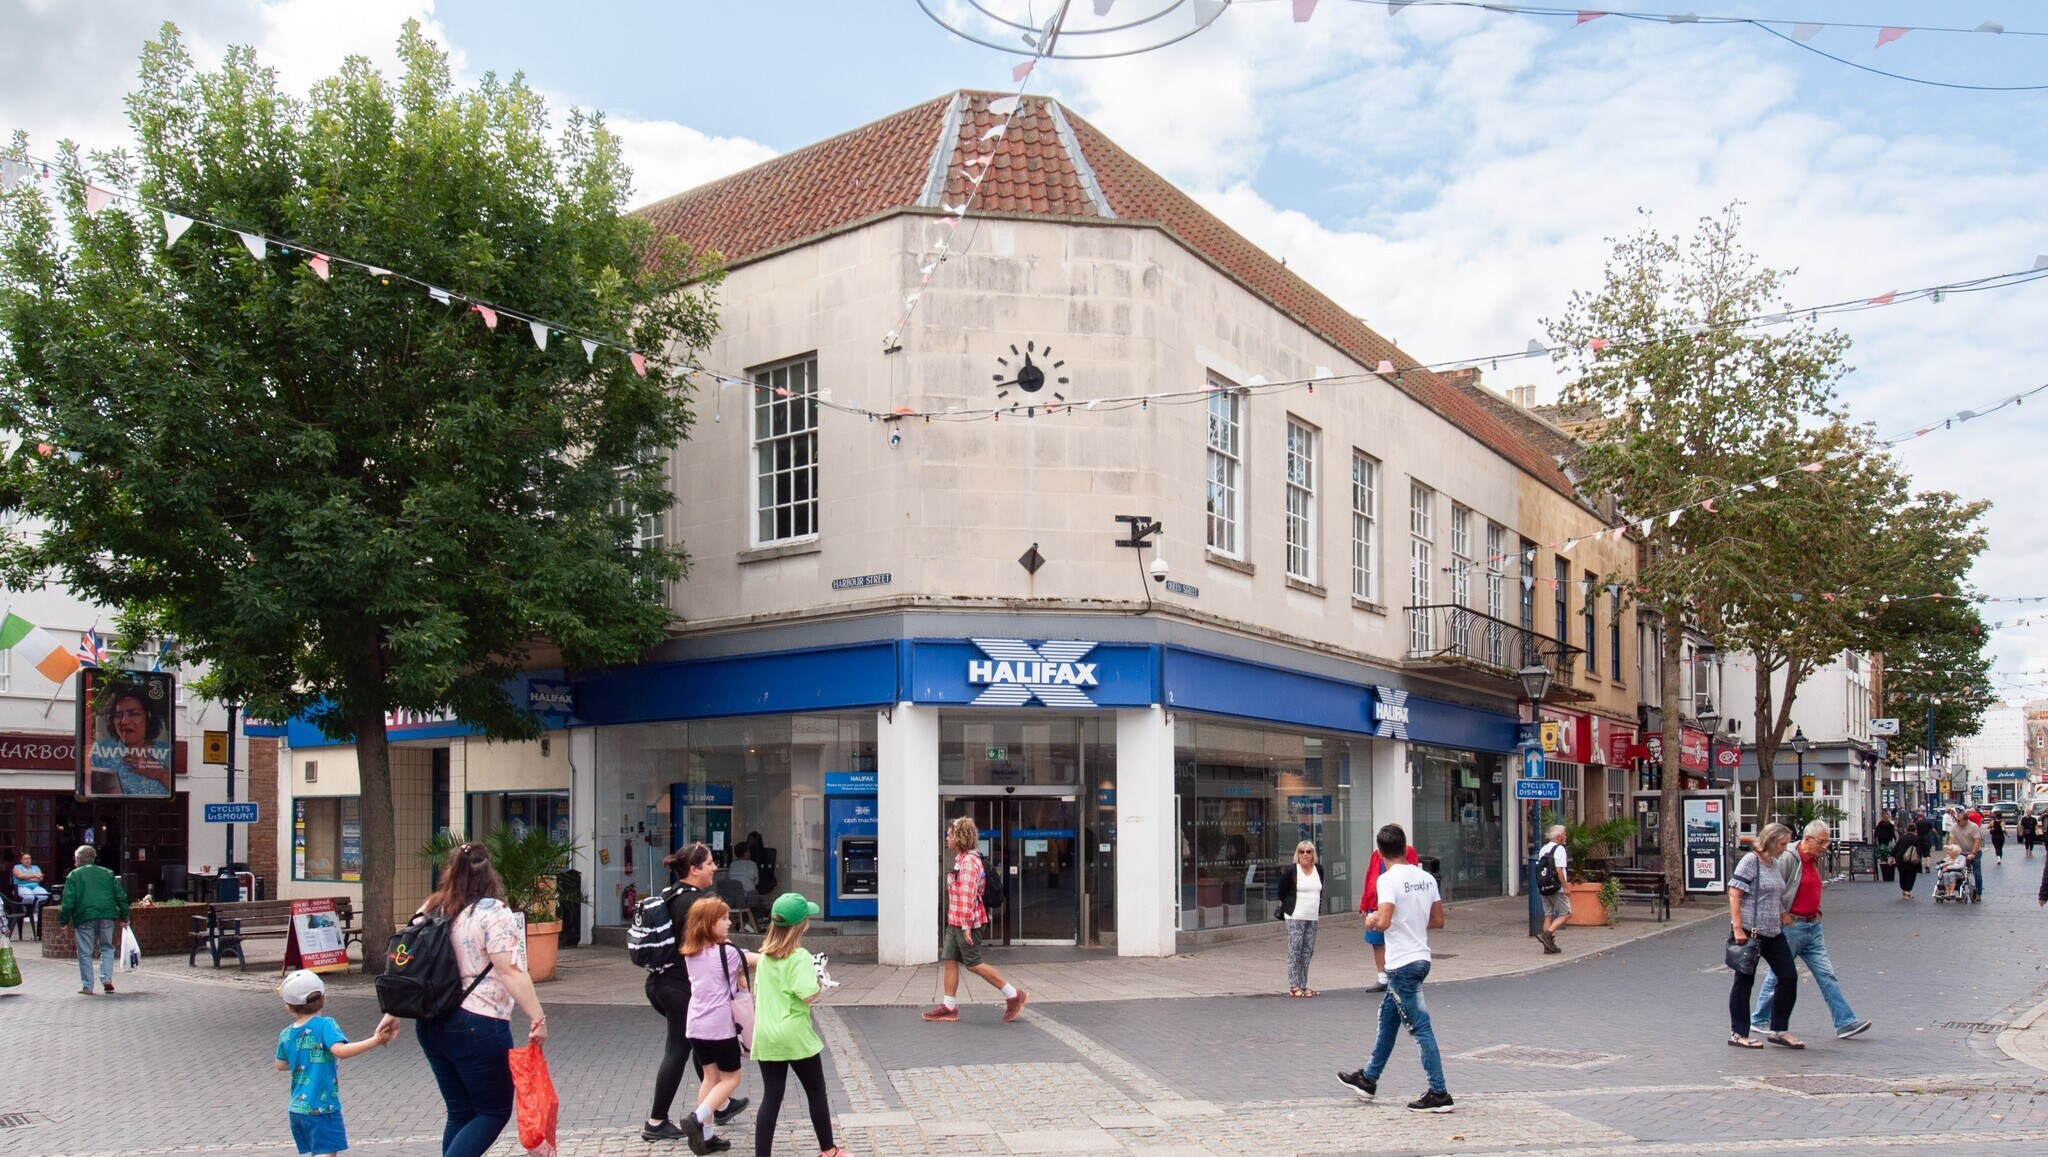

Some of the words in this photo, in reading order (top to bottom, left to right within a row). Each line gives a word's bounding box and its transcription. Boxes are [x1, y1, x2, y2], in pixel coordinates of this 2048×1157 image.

[833, 576, 864, 589] HARBOUR
[865, 573, 890, 585] STREET
[968, 660, 1099, 685] HALIFAX
[530, 692, 573, 704] HALIFAX
[1375, 702, 1410, 724] HALIFAX
[207, 812, 254, 820] DISMOUNT
[320, 950, 344, 959] QUALITY
[313, 957, 338, 966] SERVICE
